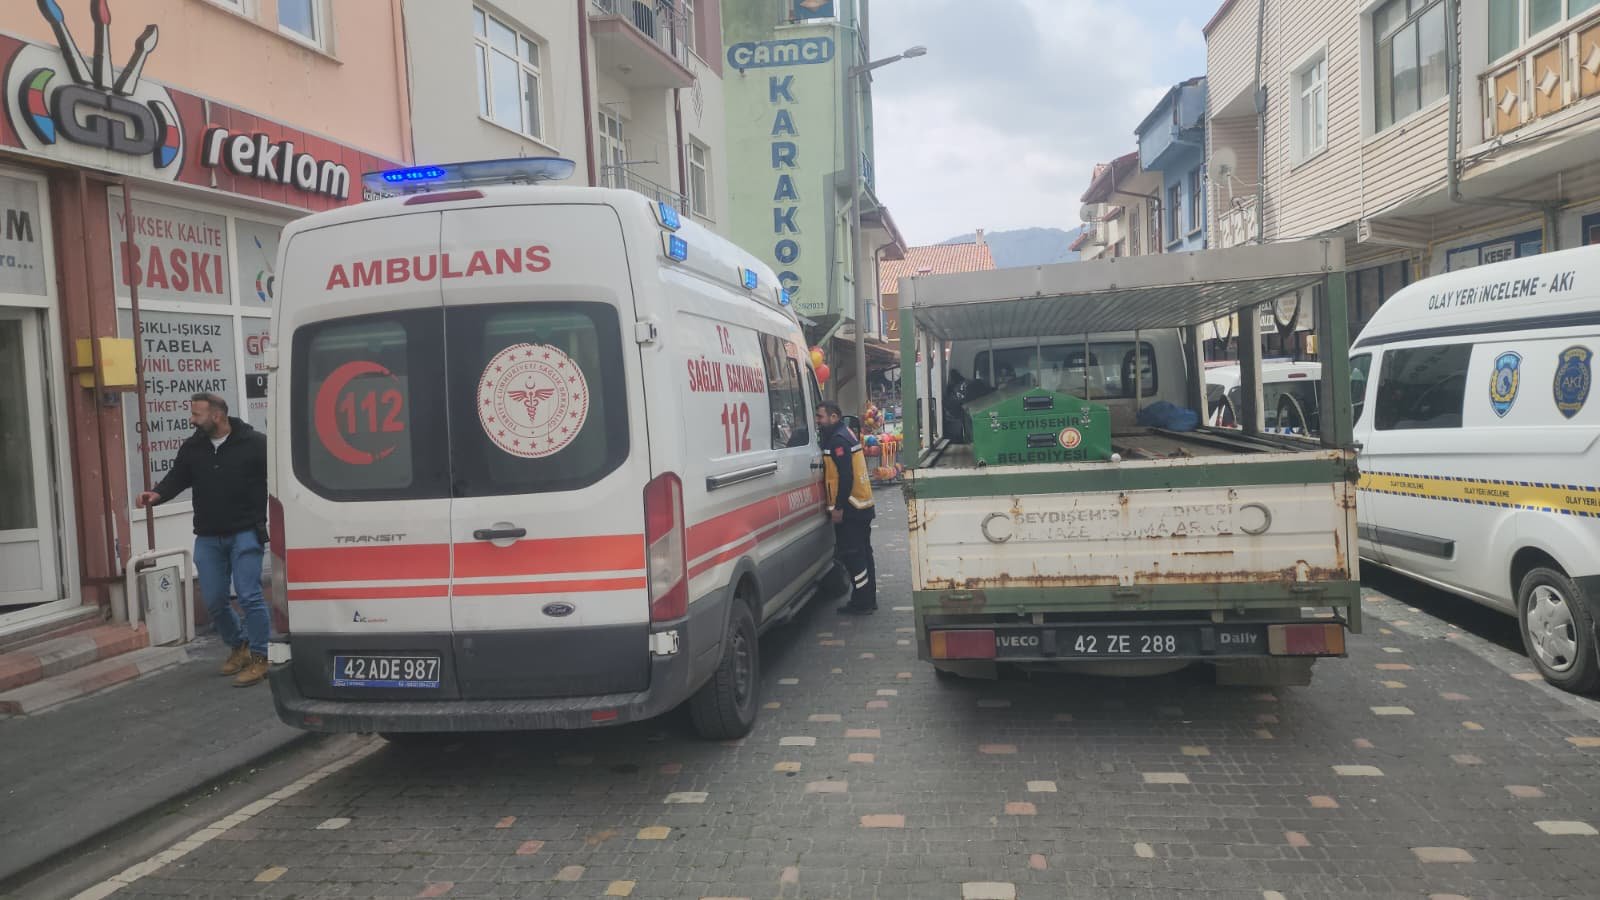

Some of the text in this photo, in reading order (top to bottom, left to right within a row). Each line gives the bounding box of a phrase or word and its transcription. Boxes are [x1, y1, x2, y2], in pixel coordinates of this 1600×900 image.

[205, 128, 351, 200] reklam
[0, 208, 34, 242] M
[177, 221, 222, 247] KALİTE
[120, 241, 224, 295] BASKI
[325, 245, 551, 290] AMBULANS
[1428, 291, 1453, 311] OLAY
[144, 339, 213, 353] TABELA
[716, 325, 735, 356] T.C.
[177, 358, 222, 373] GERME
[688, 354, 724, 392] SAĞLIK
[144, 377, 227, 396] FİŞ-PANKART
[340, 389, 405, 434] 112
[721, 402, 752, 454] 112
[1001, 416, 1080, 431] SEYDİŞEHİR
[333, 533, 407, 543] TRANSIT
[996, 636, 1039, 647] IVECO
[1075, 635, 1176, 652] 42 ZE 288
[1220, 632, 1258, 644] Daily
[344, 658, 437, 680] 42 ADE 987
